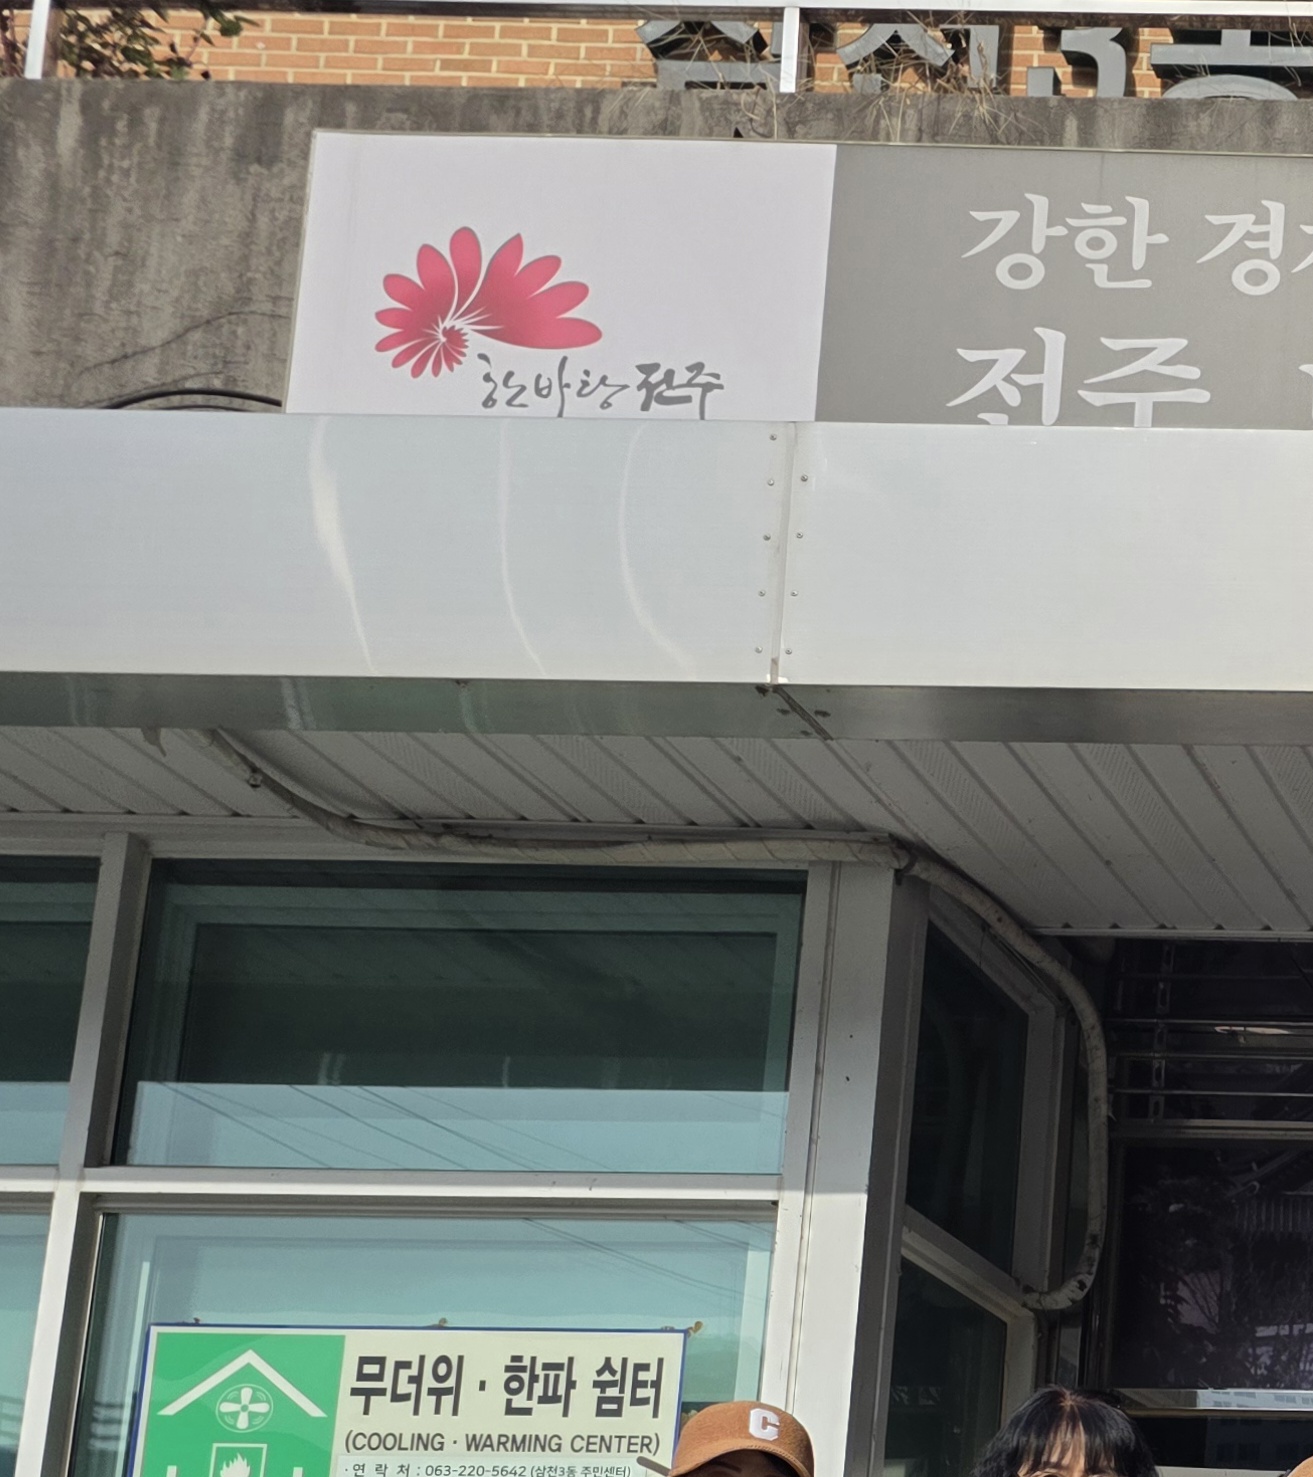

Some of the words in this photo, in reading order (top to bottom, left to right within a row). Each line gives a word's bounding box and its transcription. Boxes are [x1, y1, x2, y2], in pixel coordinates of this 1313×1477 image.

[962, 193, 1169, 290] 강한
[946, 327, 1211, 428] 전주
[349, 1354, 465, 1417] 무더위
[503, 1354, 577, 1418] 한파
[592, 1356, 664, 1419] 쉼터
[345, 1430, 445, 1454] (COOLING
[465, 1434, 562, 1453] WARMING
[570, 1434, 660, 1458] CENTER)
[748, 1407, 781, 1441] C
[425, 1464, 527, 1477] 063-220-5642
